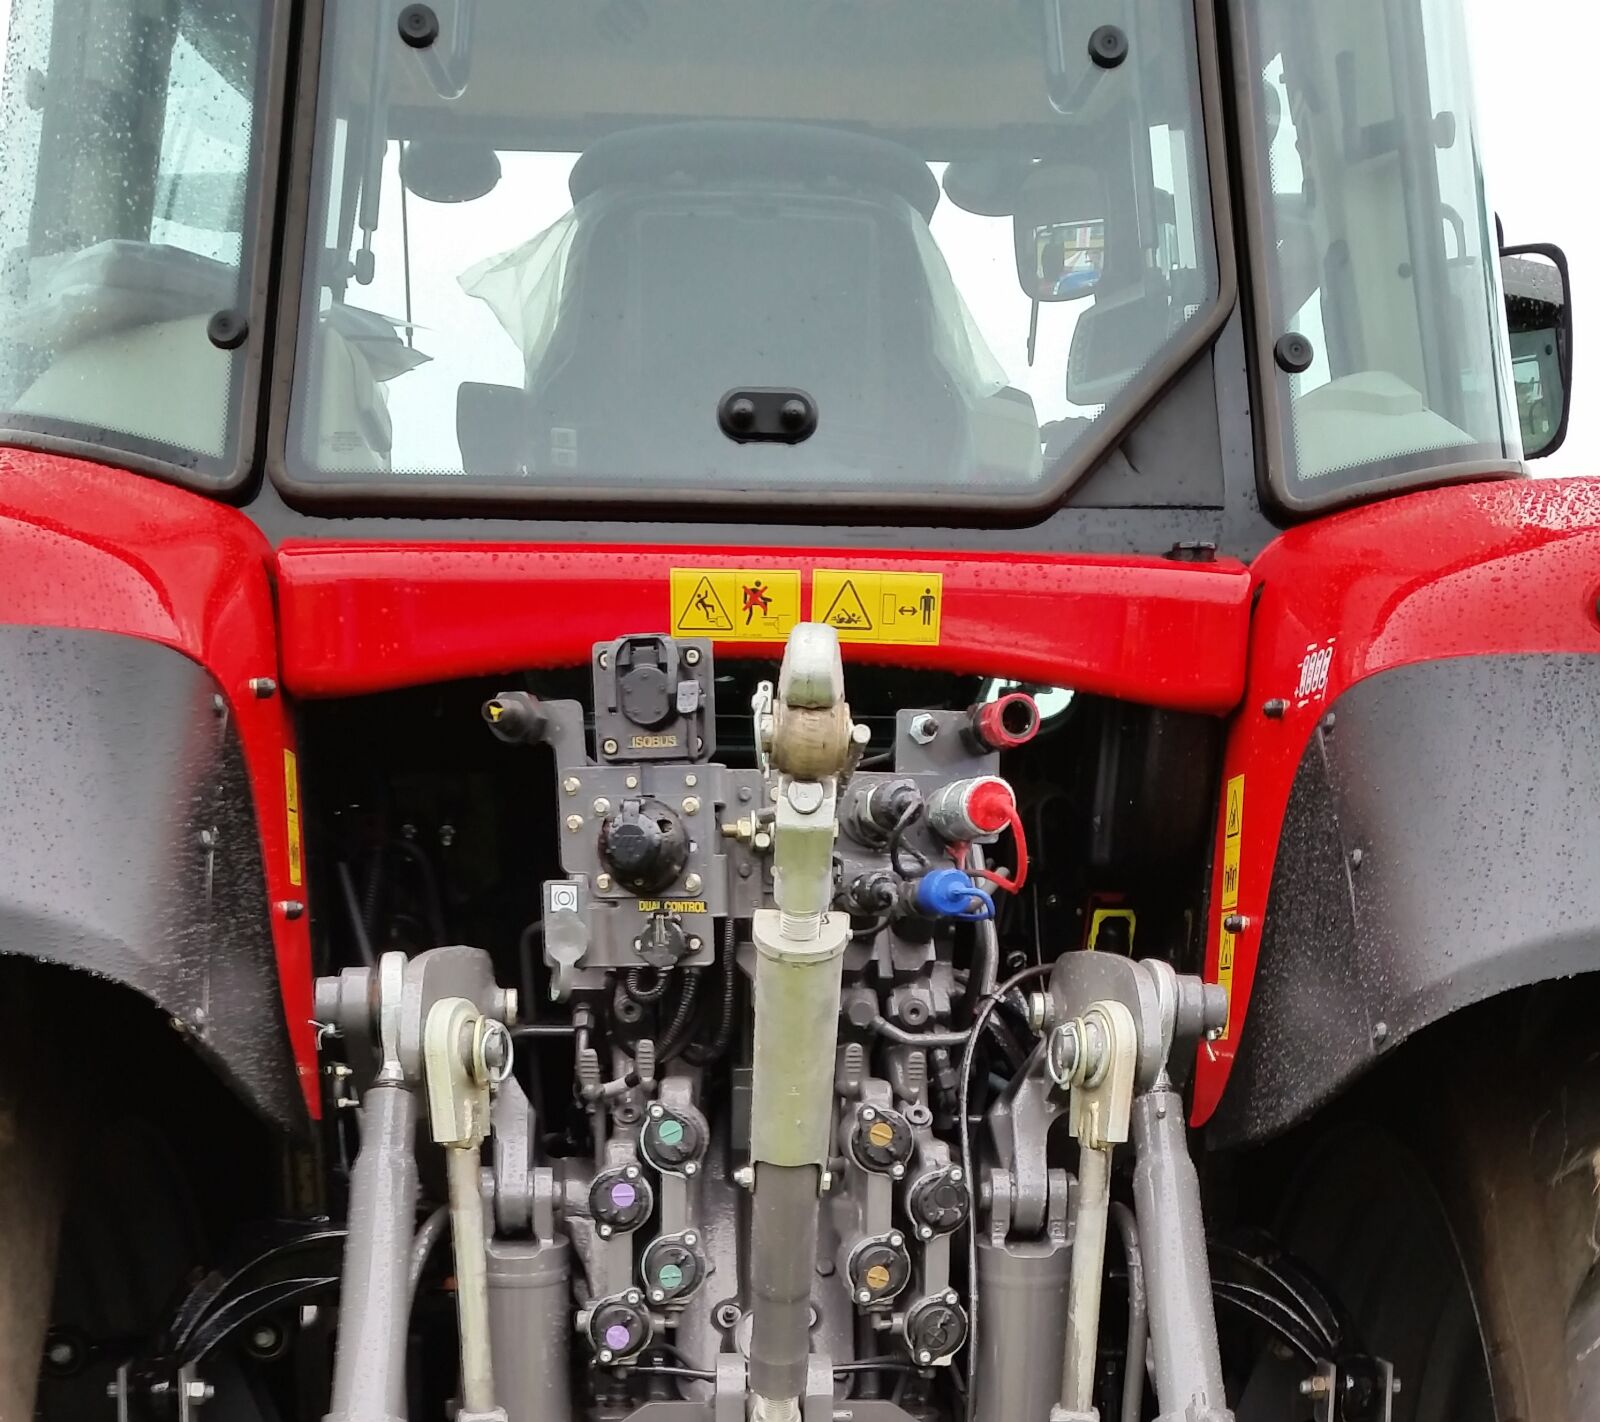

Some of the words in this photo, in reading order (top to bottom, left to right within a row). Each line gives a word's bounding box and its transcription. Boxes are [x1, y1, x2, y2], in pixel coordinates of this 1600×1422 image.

[631, 735, 677, 748] ISOBUS
[638, 900, 661, 912] DUAL
[663, 901, 708, 913] CONTROL
